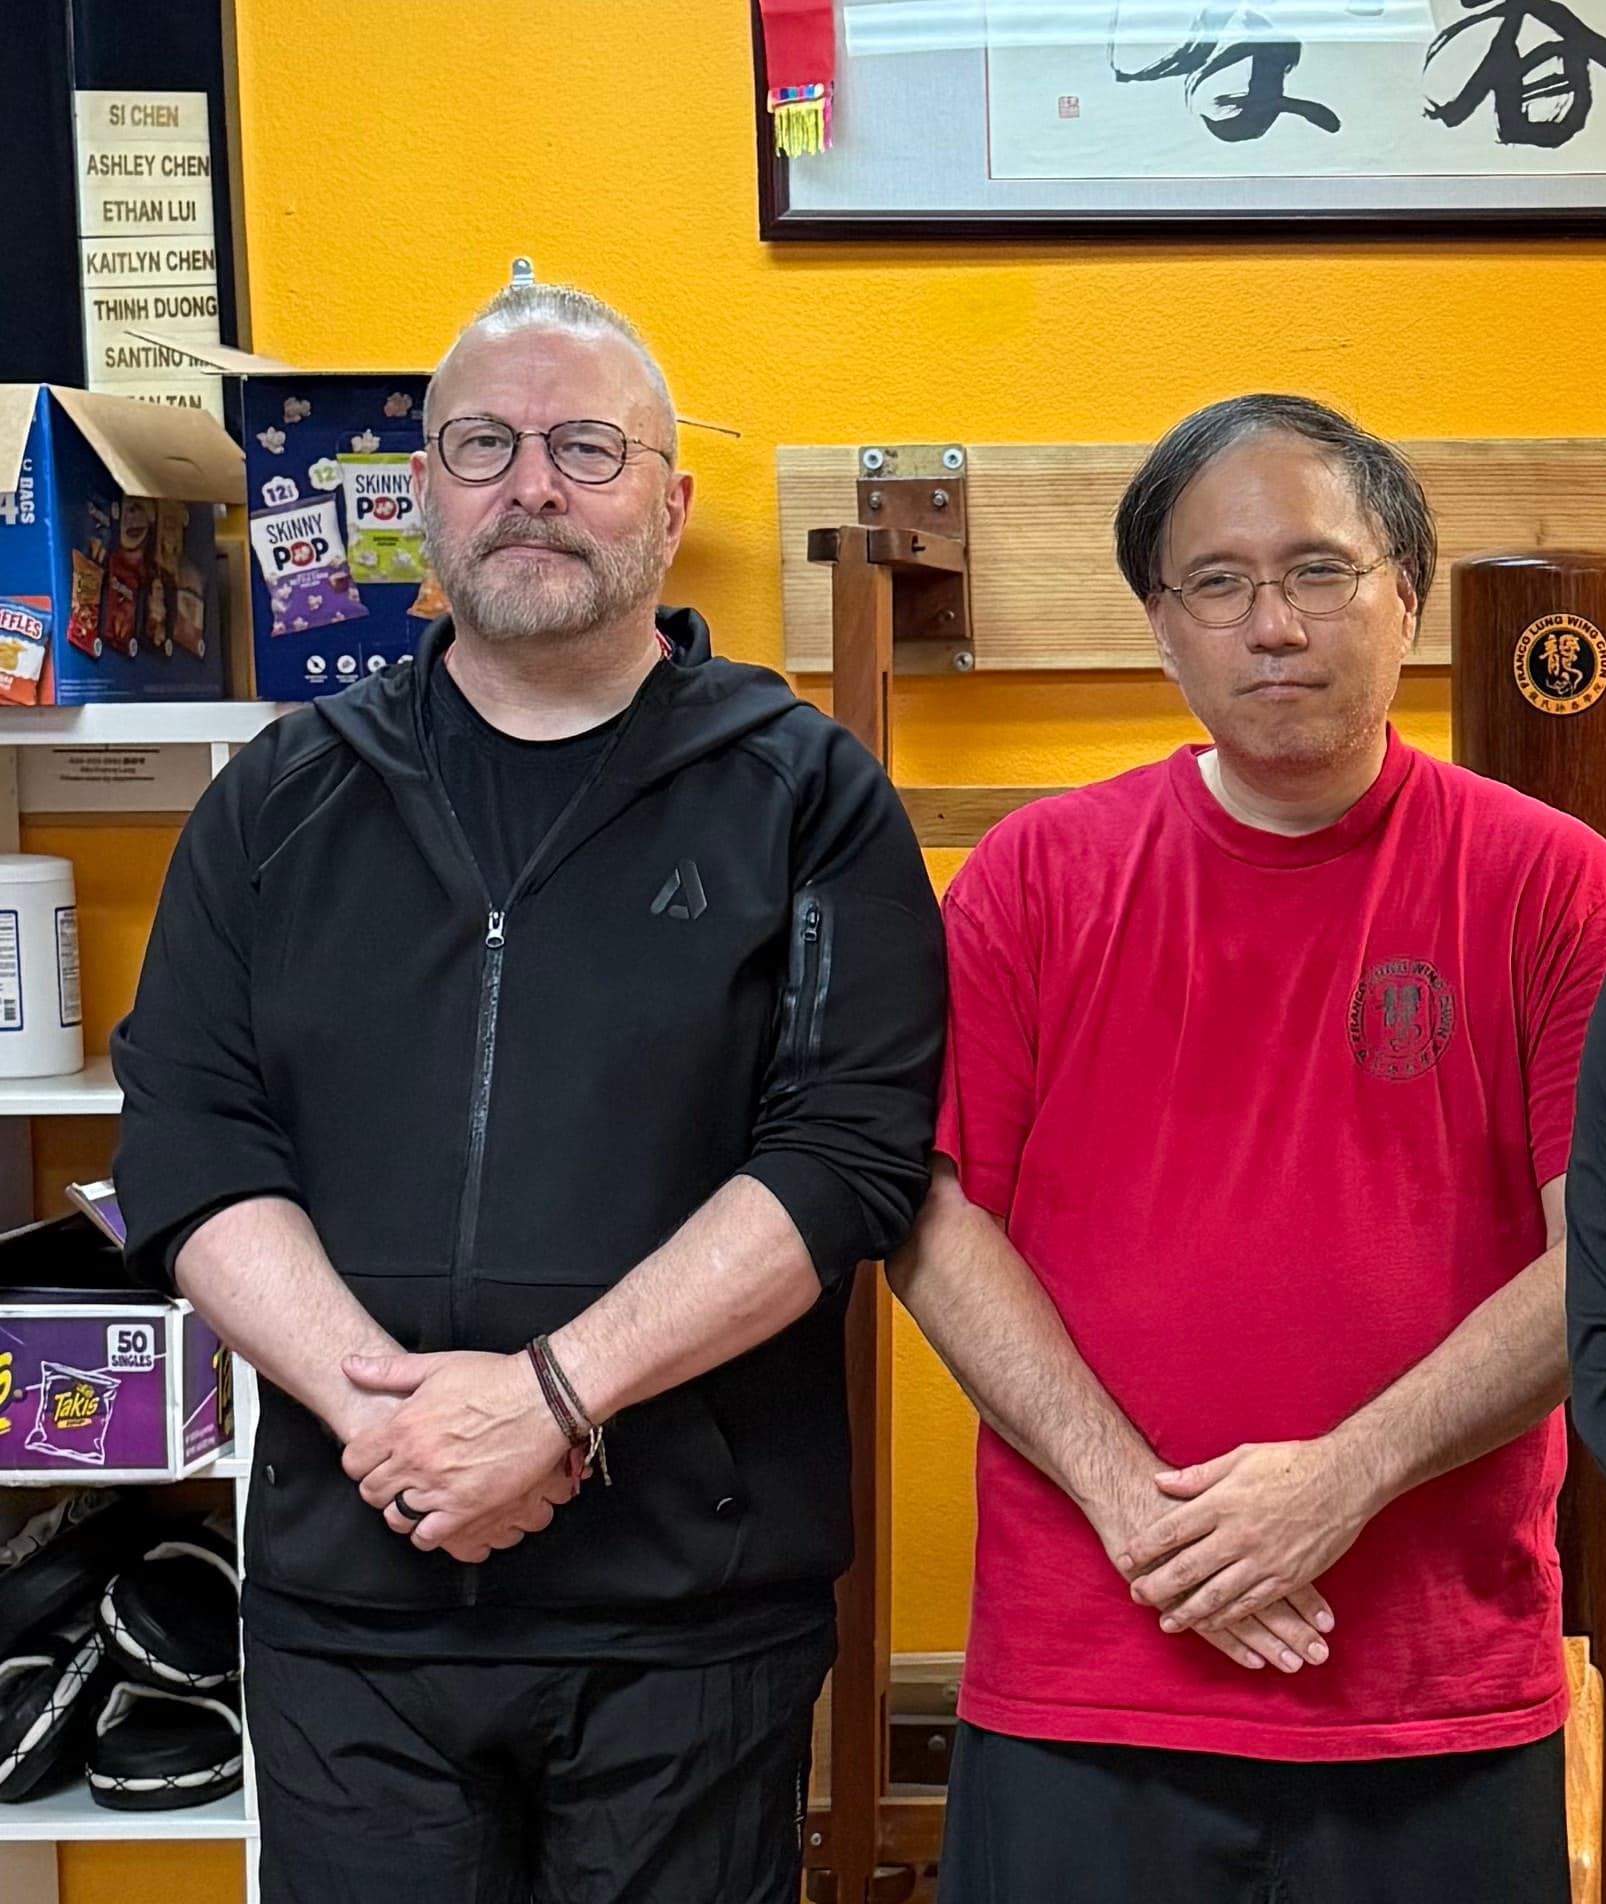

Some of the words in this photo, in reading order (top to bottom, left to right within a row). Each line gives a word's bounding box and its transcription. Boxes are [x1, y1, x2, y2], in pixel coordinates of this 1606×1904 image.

[109, 104, 125, 126] SI
[130, 105, 179, 127] CHEN
[87, 154, 155, 176] ASHLEY
[161, 155, 210, 176] CHEN
[103, 200, 164, 222] ETHAN
[168, 200, 196, 222] LUI
[87, 251, 161, 275] KAITLYN
[166, 249, 215, 271] CHEN
[93, 298, 149, 321] THINH
[154, 295, 218, 318] DUONG
[105, 347, 183, 368] SANTINO
[20, 477, 35, 524] BAGS
[356, 496, 413, 520] POP
[273, 537, 329, 570] POP
[0, 610, 41, 638] FFLES
[1529, 616, 1562, 636] LUNG
[1567, 616, 1598, 639] WING
[117, 1330, 148, 1353] 50
[111, 1355, 153, 1367] SINGLES
[54, 1391, 100, 1422] Takis
